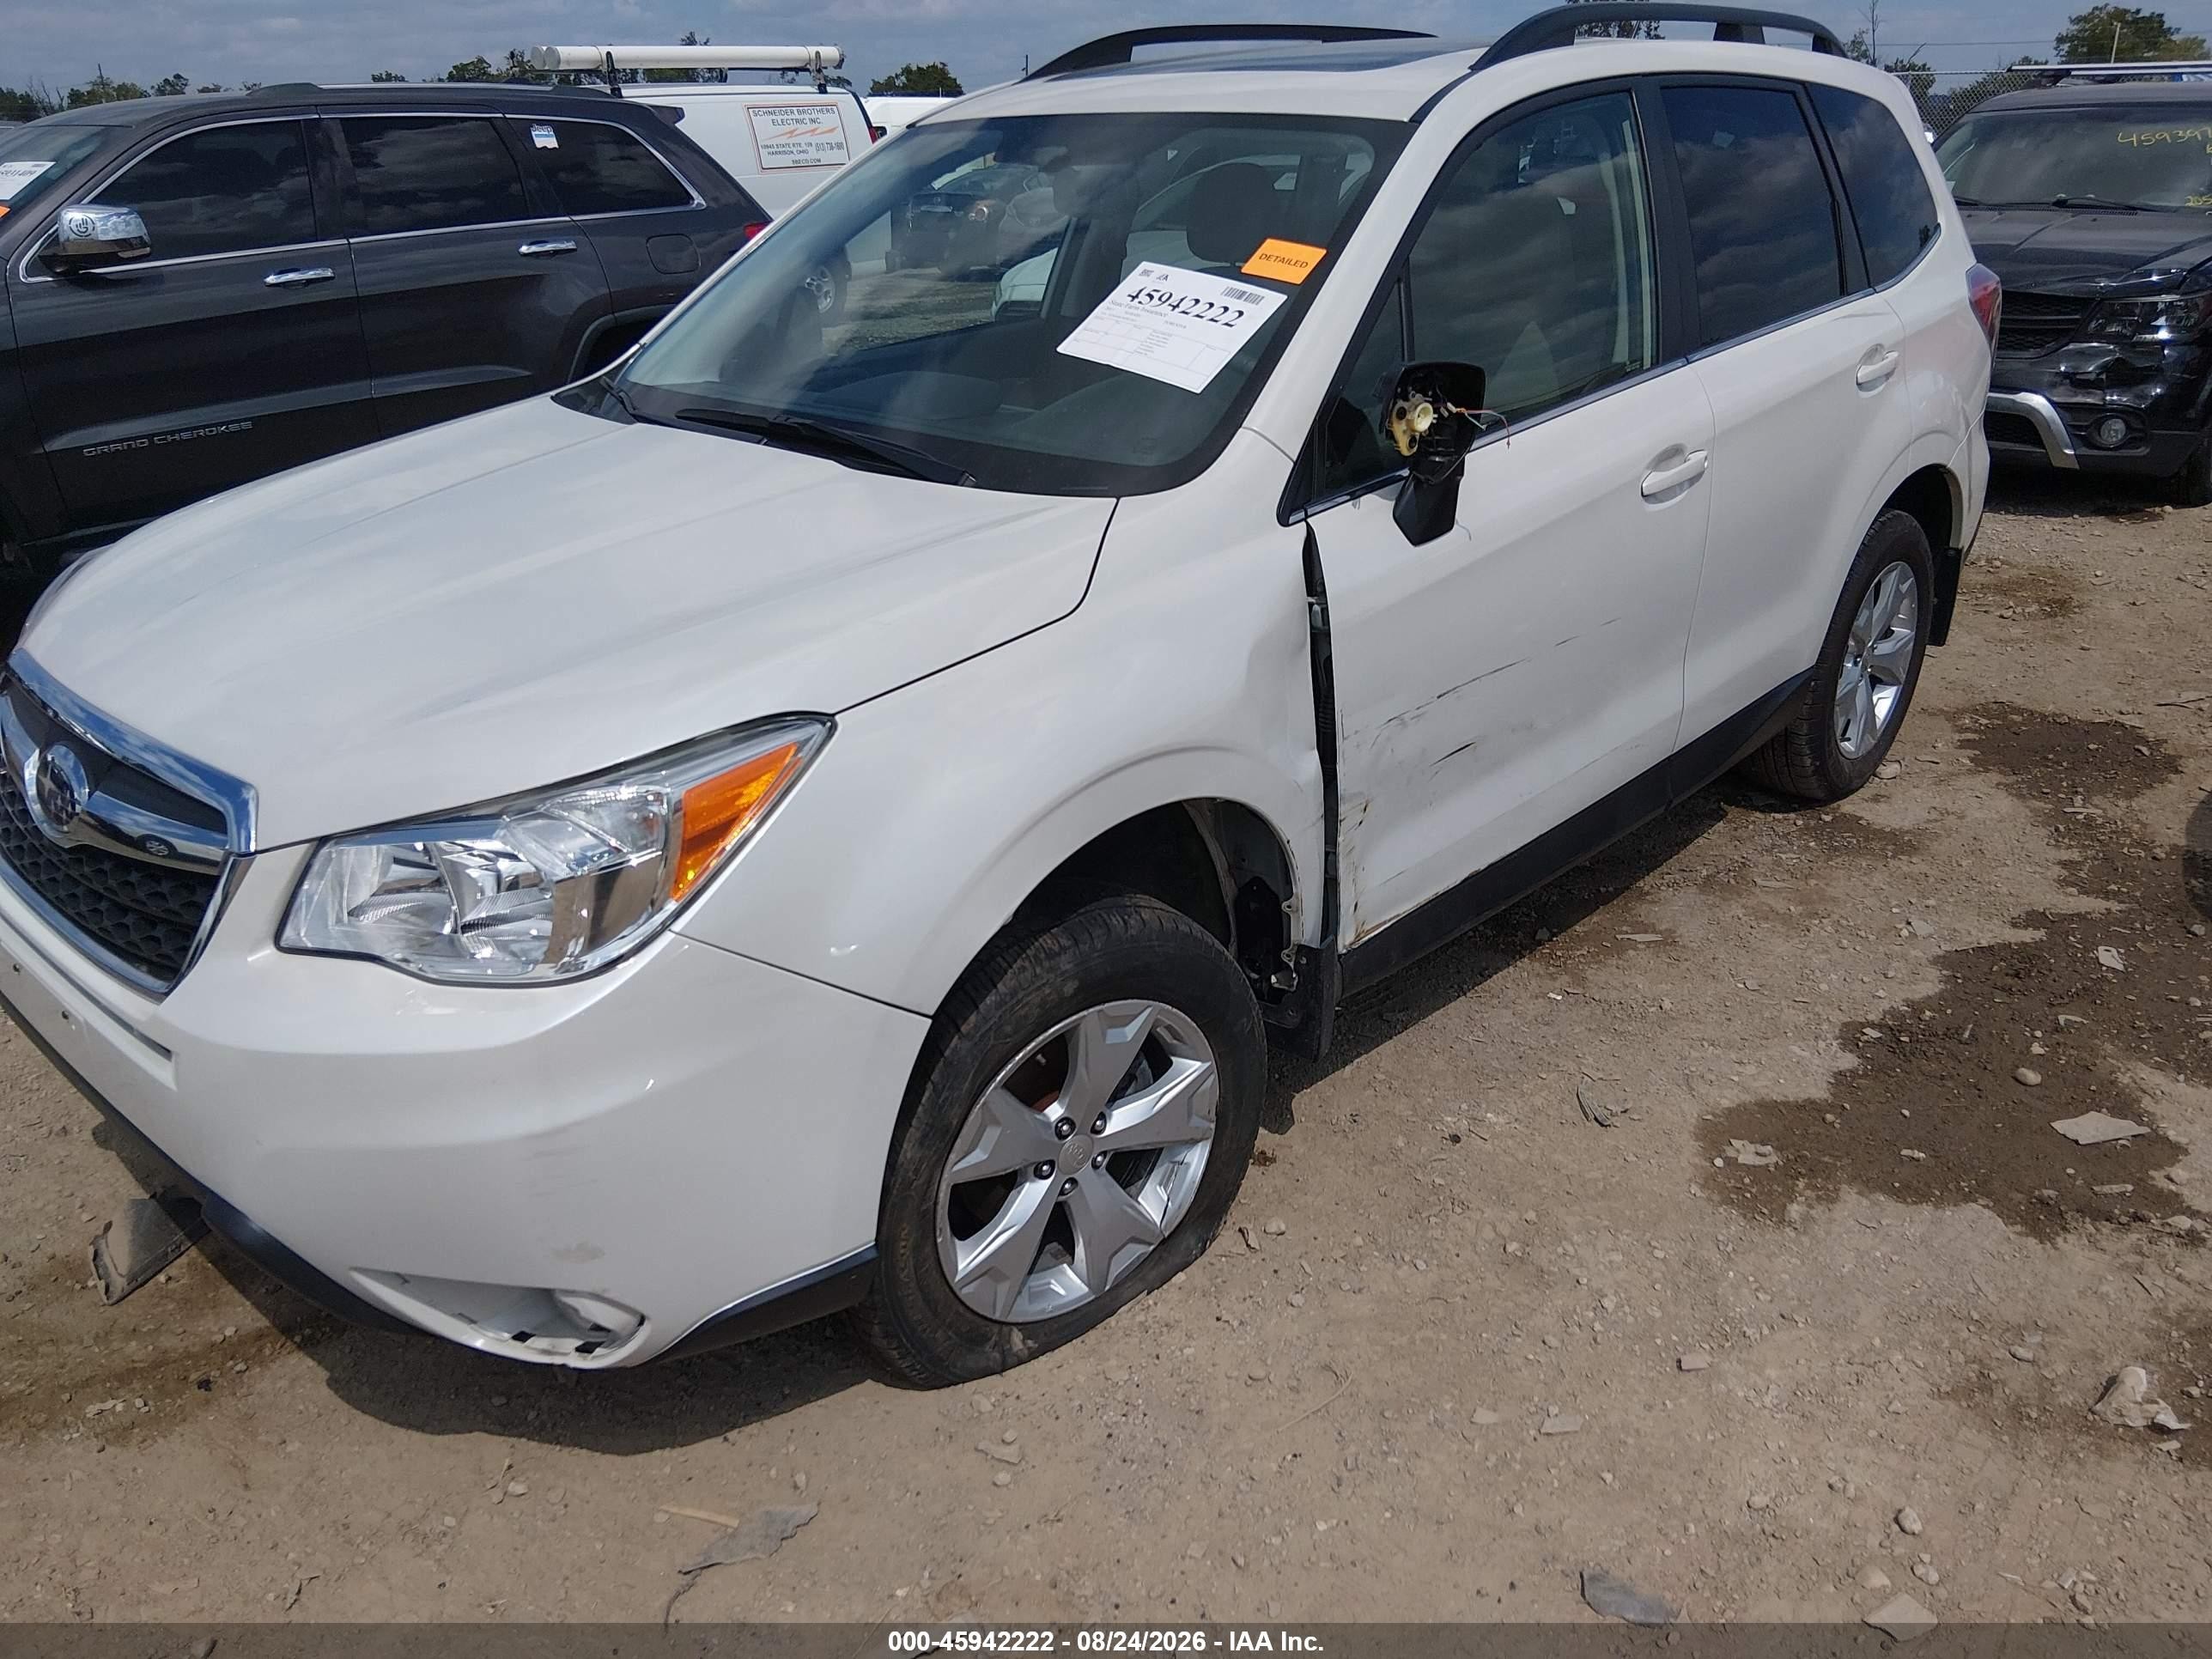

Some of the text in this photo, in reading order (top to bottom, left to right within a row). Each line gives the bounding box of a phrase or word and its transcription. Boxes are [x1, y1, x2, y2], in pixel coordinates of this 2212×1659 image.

[752, 107, 836, 118] SCHNEIDER BROTHERS
[771, 117, 823, 126] ELECTRIC INC.
[530, 123, 554, 135] Jeep
[1258, 252, 1309, 269] DETAILED
[1127, 286, 1244, 328] 45942222
[82, 421, 253, 456] GRAND CHEROKEE
